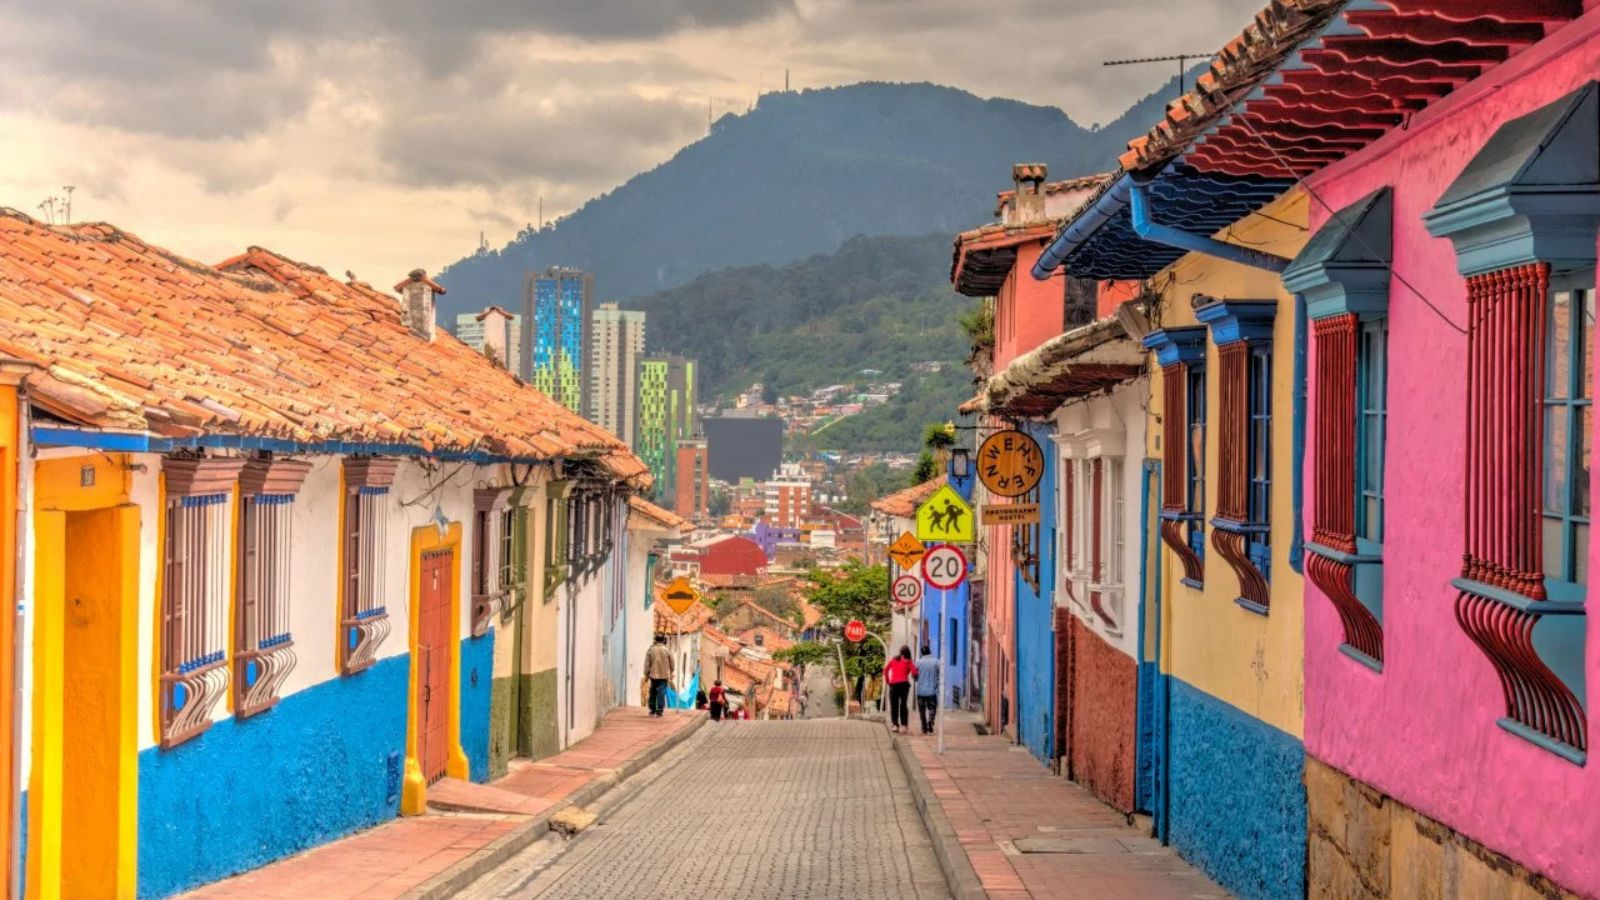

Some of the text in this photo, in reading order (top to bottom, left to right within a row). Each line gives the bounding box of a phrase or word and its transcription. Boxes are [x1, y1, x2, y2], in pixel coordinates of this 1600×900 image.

[931, 556, 959, 578] 20
[897, 583, 916, 597] 20
[846, 626, 864, 636] PARE
